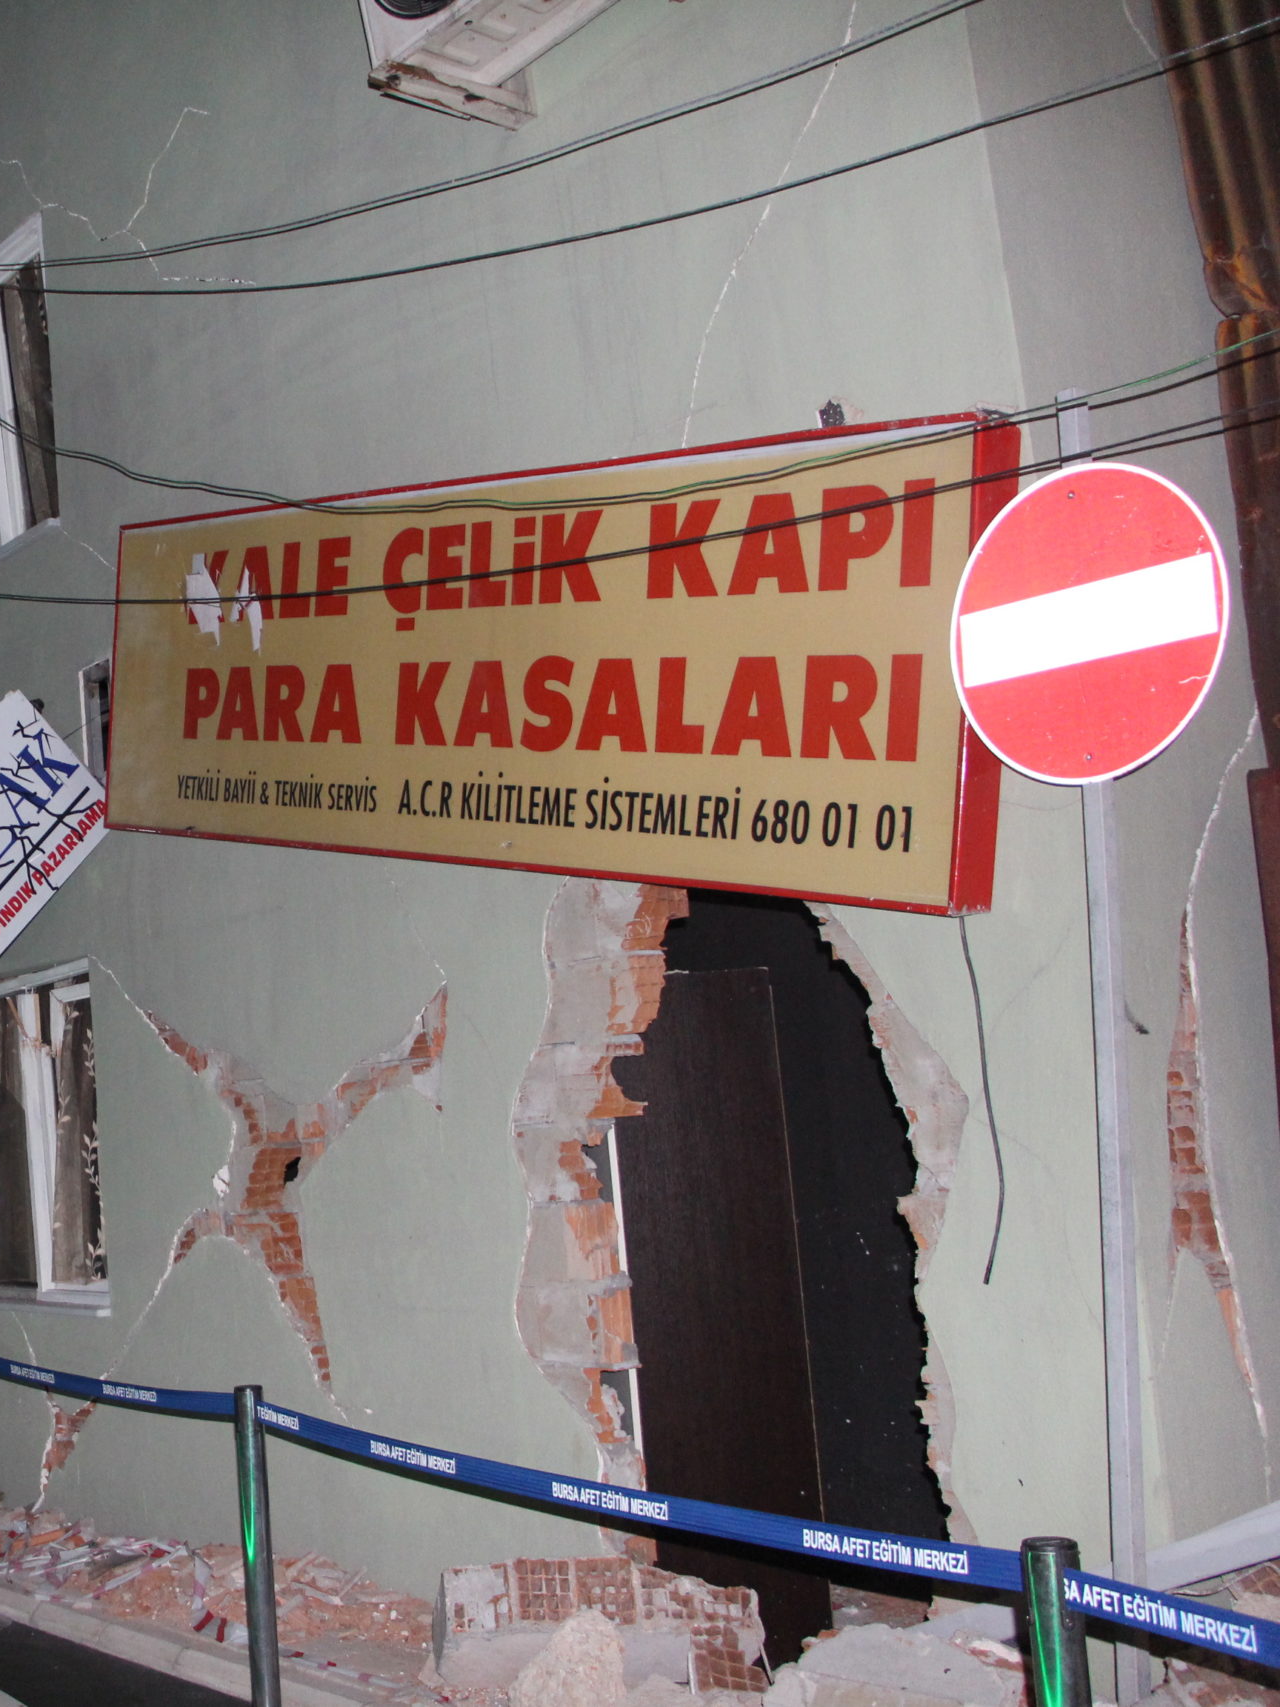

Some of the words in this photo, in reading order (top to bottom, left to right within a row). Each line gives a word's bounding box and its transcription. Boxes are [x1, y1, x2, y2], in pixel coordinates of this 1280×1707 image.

[646, 478, 935, 600] KAPI
[183, 663, 362, 745] PARA
[394, 653, 924, 762] KASALARI
[259, 780, 270, 806] &
[397, 778, 453, 819] A.C.R
[750, 799, 811, 845] 680
[821, 801, 859, 849] 01
[874, 804, 913, 853] 01
[370, 1440, 391, 1458] BURSA
[390, 1445, 406, 1462] AFET
[551, 1481, 580, 1502] BURSA
[579, 1487, 601, 1507] AFET
[802, 1528, 841, 1554] BURSA
[842, 1536, 871, 1559] AFET
[872, 1539, 912, 1567] EĞİTİM
[914, 1548, 969, 1575] MERKEZİ
[1082, 1583, 1121, 1614] AFET
[1122, 1593, 1178, 1631] EĞİTİM
[1180, 1610, 1258, 1654] MERKEZİ
